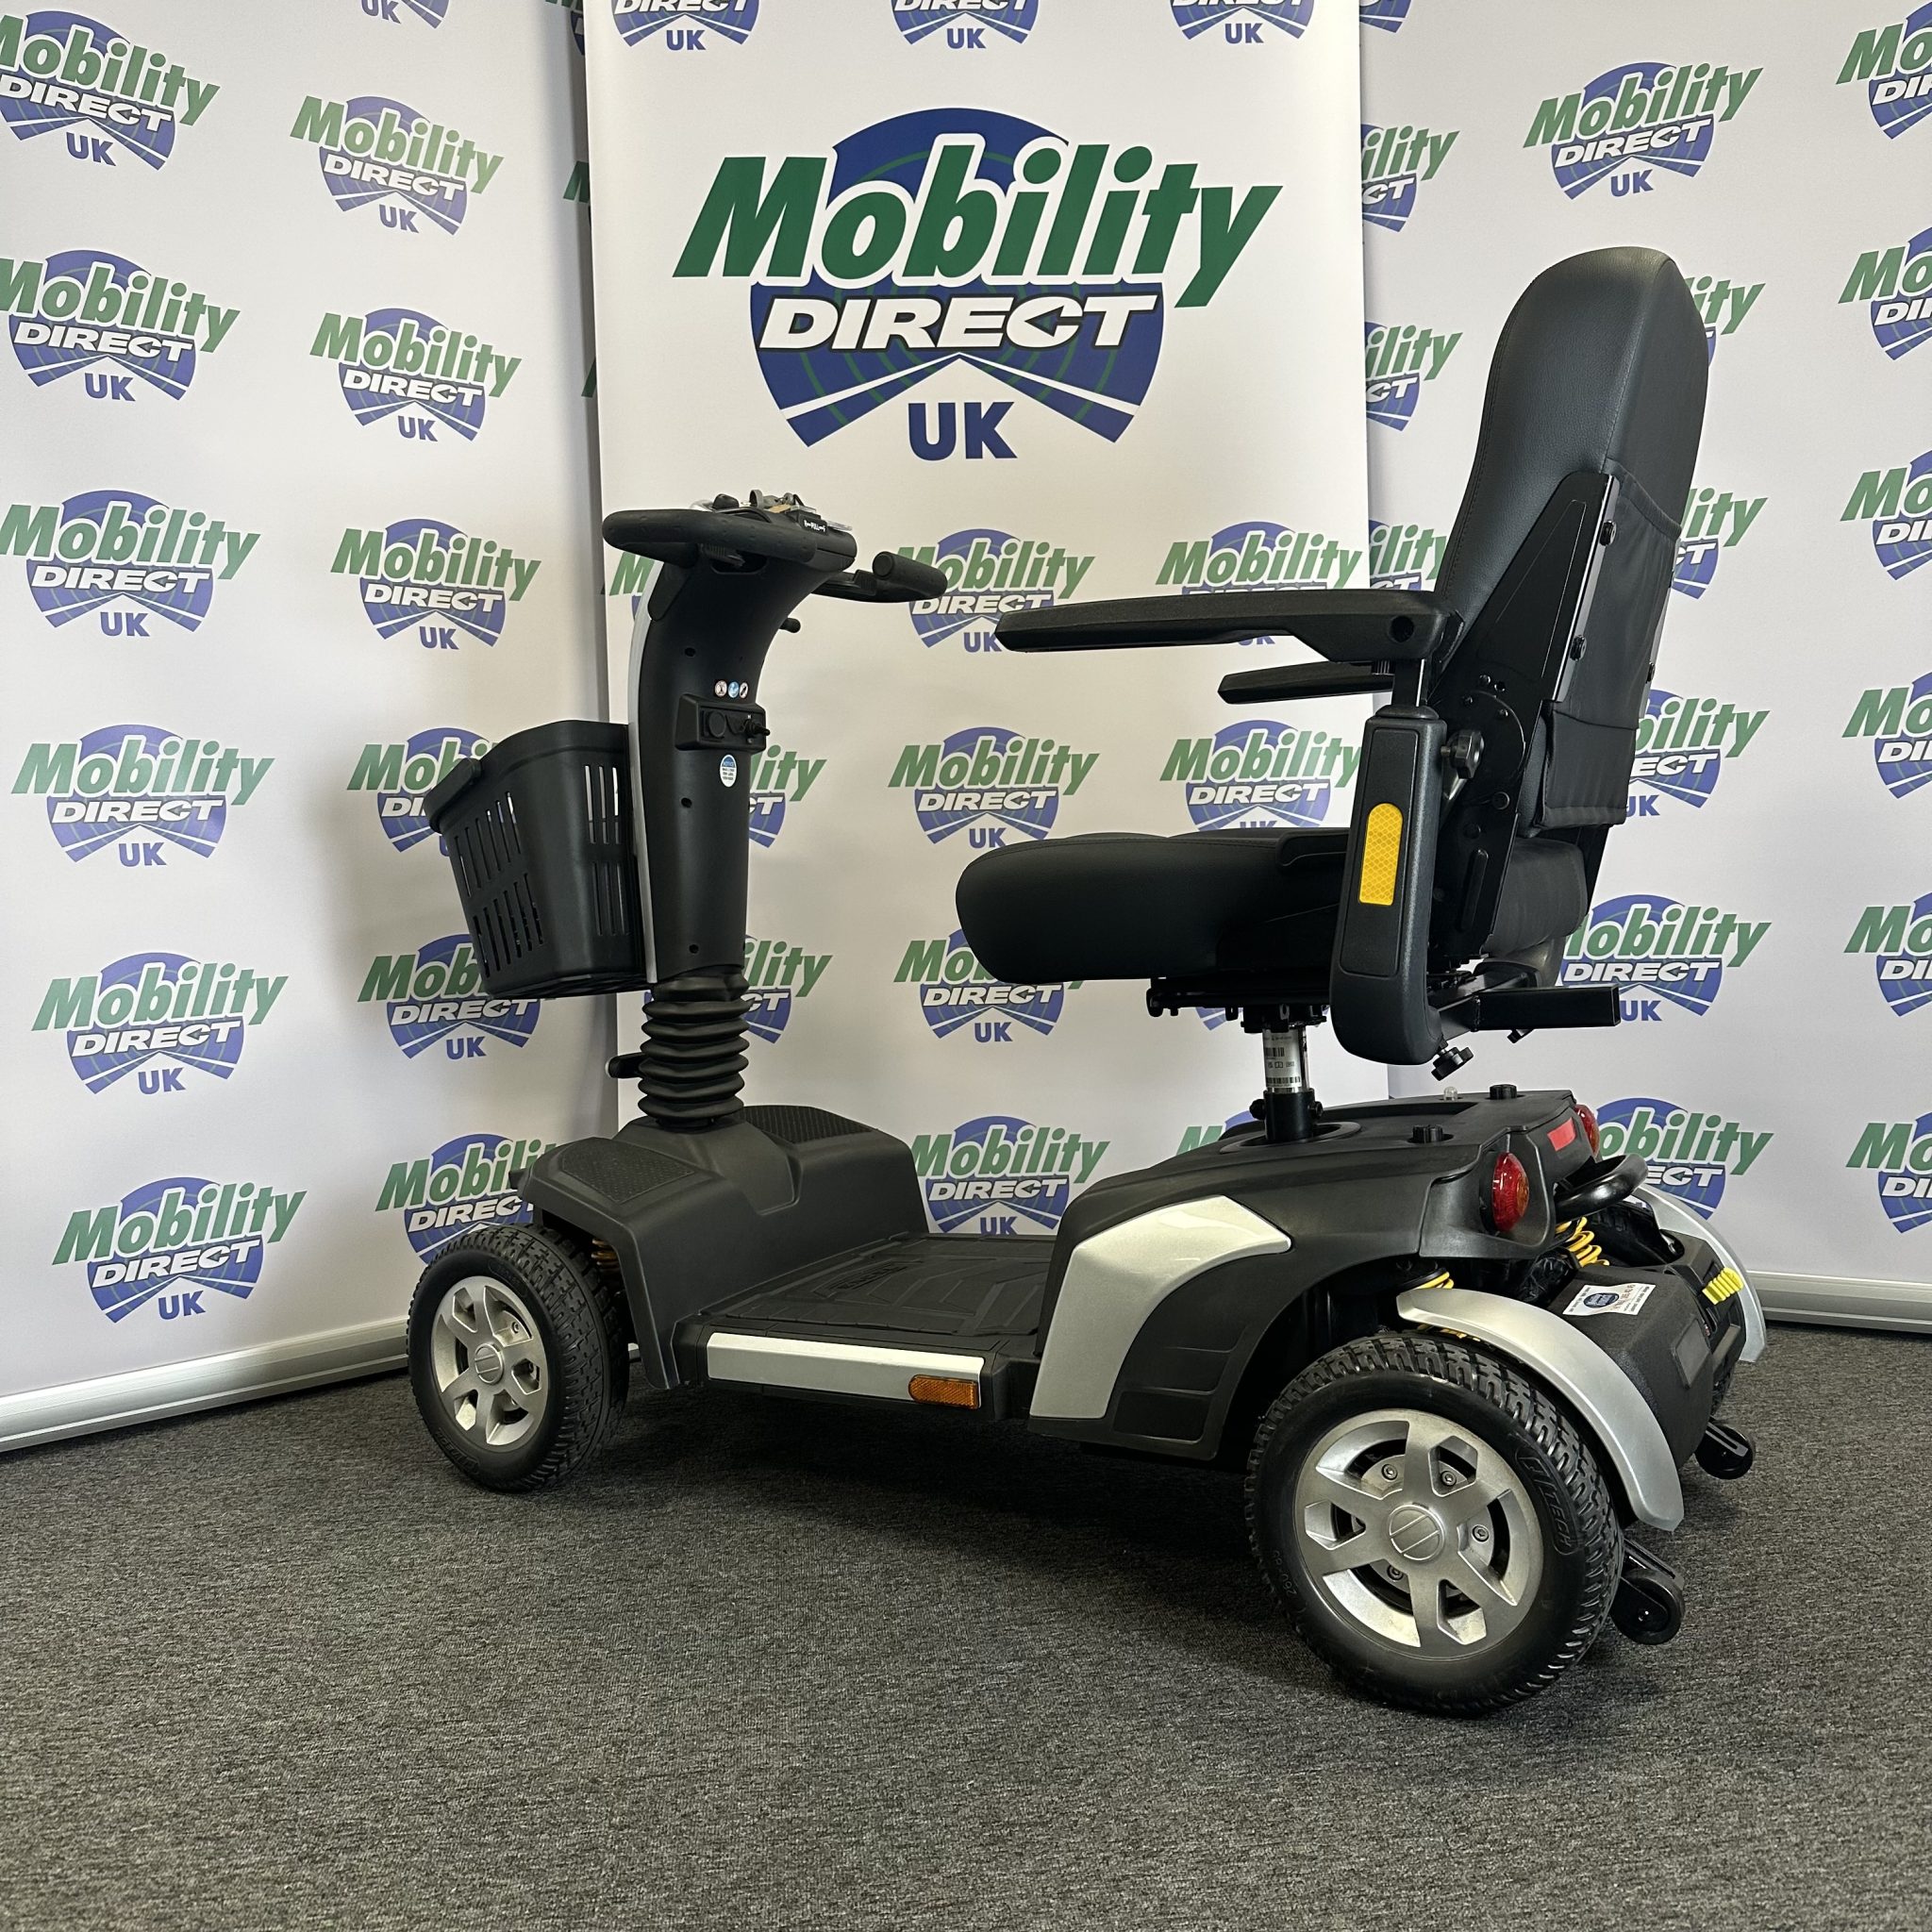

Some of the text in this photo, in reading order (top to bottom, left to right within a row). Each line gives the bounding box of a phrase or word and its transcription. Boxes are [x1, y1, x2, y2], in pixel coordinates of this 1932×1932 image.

[361, 0, 401, 24] UK
[667, 29, 707, 51] UK
[947, 28, 987, 50] UK
[1225, 23, 1264, 44] UK
[0, 75, 174, 133] DIRECT
[1524, 63, 1764, 148] Mobility
[66, 132, 116, 167] UK
[290, 95, 504, 193] Mobility
[1361, 125, 1460, 182] ility
[1554, 117, 1711, 170] DIRECT
[323, 153, 465, 201] DIRECT
[1610, 169, 1655, 197] UK
[379, 204, 420, 233] UK
[672, 143, 1284, 309] Mobility
[0, 258, 241, 353] Mobility
[758, 294, 1158, 351] DIRECT
[13, 322, 193, 363] DIRECT
[309, 312, 523, 398] Mobility
[1365, 325, 1463, 381] ility
[85, 373, 136, 402] UK
[341, 368, 484, 408] DIRECT
[398, 415, 439, 441] UK
[908, 401, 1018, 461] UK
[0, 504, 261, 580] Mobility
[1368, 525, 1450, 581] ility
[330, 527, 541, 601] Mobility
[1156, 532, 1363, 590] Mobility
[30, 566, 210, 593] DIRECT
[363, 584, 504, 614] DIRECT
[911, 594, 1053, 616] DIRECT
[100, 611, 150, 638] UK
[419, 626, 459, 650] UK
[963, 632, 1002, 653] UK
[11, 739, 275, 806] Mobility
[889, 739, 1099, 796] Mobility
[1160, 731, 1366, 789] Mobility
[1630, 752, 1719, 777] ECT
[917, 789, 1059, 812] DIRECT
[1189, 782, 1328, 806] DIRECT
[51, 799, 224, 824] DIRECT
[118, 841, 168, 867] UK
[969, 828, 1006, 849] UK
[1562, 961, 1721, 983] DIRECT
[31, 962, 289, 1032] Mobility
[390, 997, 538, 1026] DIRECT
[923, 984, 1062, 1008] DIRECT
[1621, 1000, 1662, 1022] UK
[71, 1020, 242, 1058] DIRECT
[446, 1036, 487, 1060] UK
[974, 1022, 1013, 1043] UK
[137, 1067, 187, 1095] UK
[910, 1126, 1110, 1185] Mobility
[1599, 1110, 1775, 1175] obility
[928, 1178, 1069, 1202] DIRECT
[52, 1182, 308, 1266] Mobility
[409, 1197, 535, 1232] DIREC
[980, 1217, 1017, 1235] UK
[92, 1239, 262, 1289] DIRECT
[158, 1290, 207, 1321] UK
